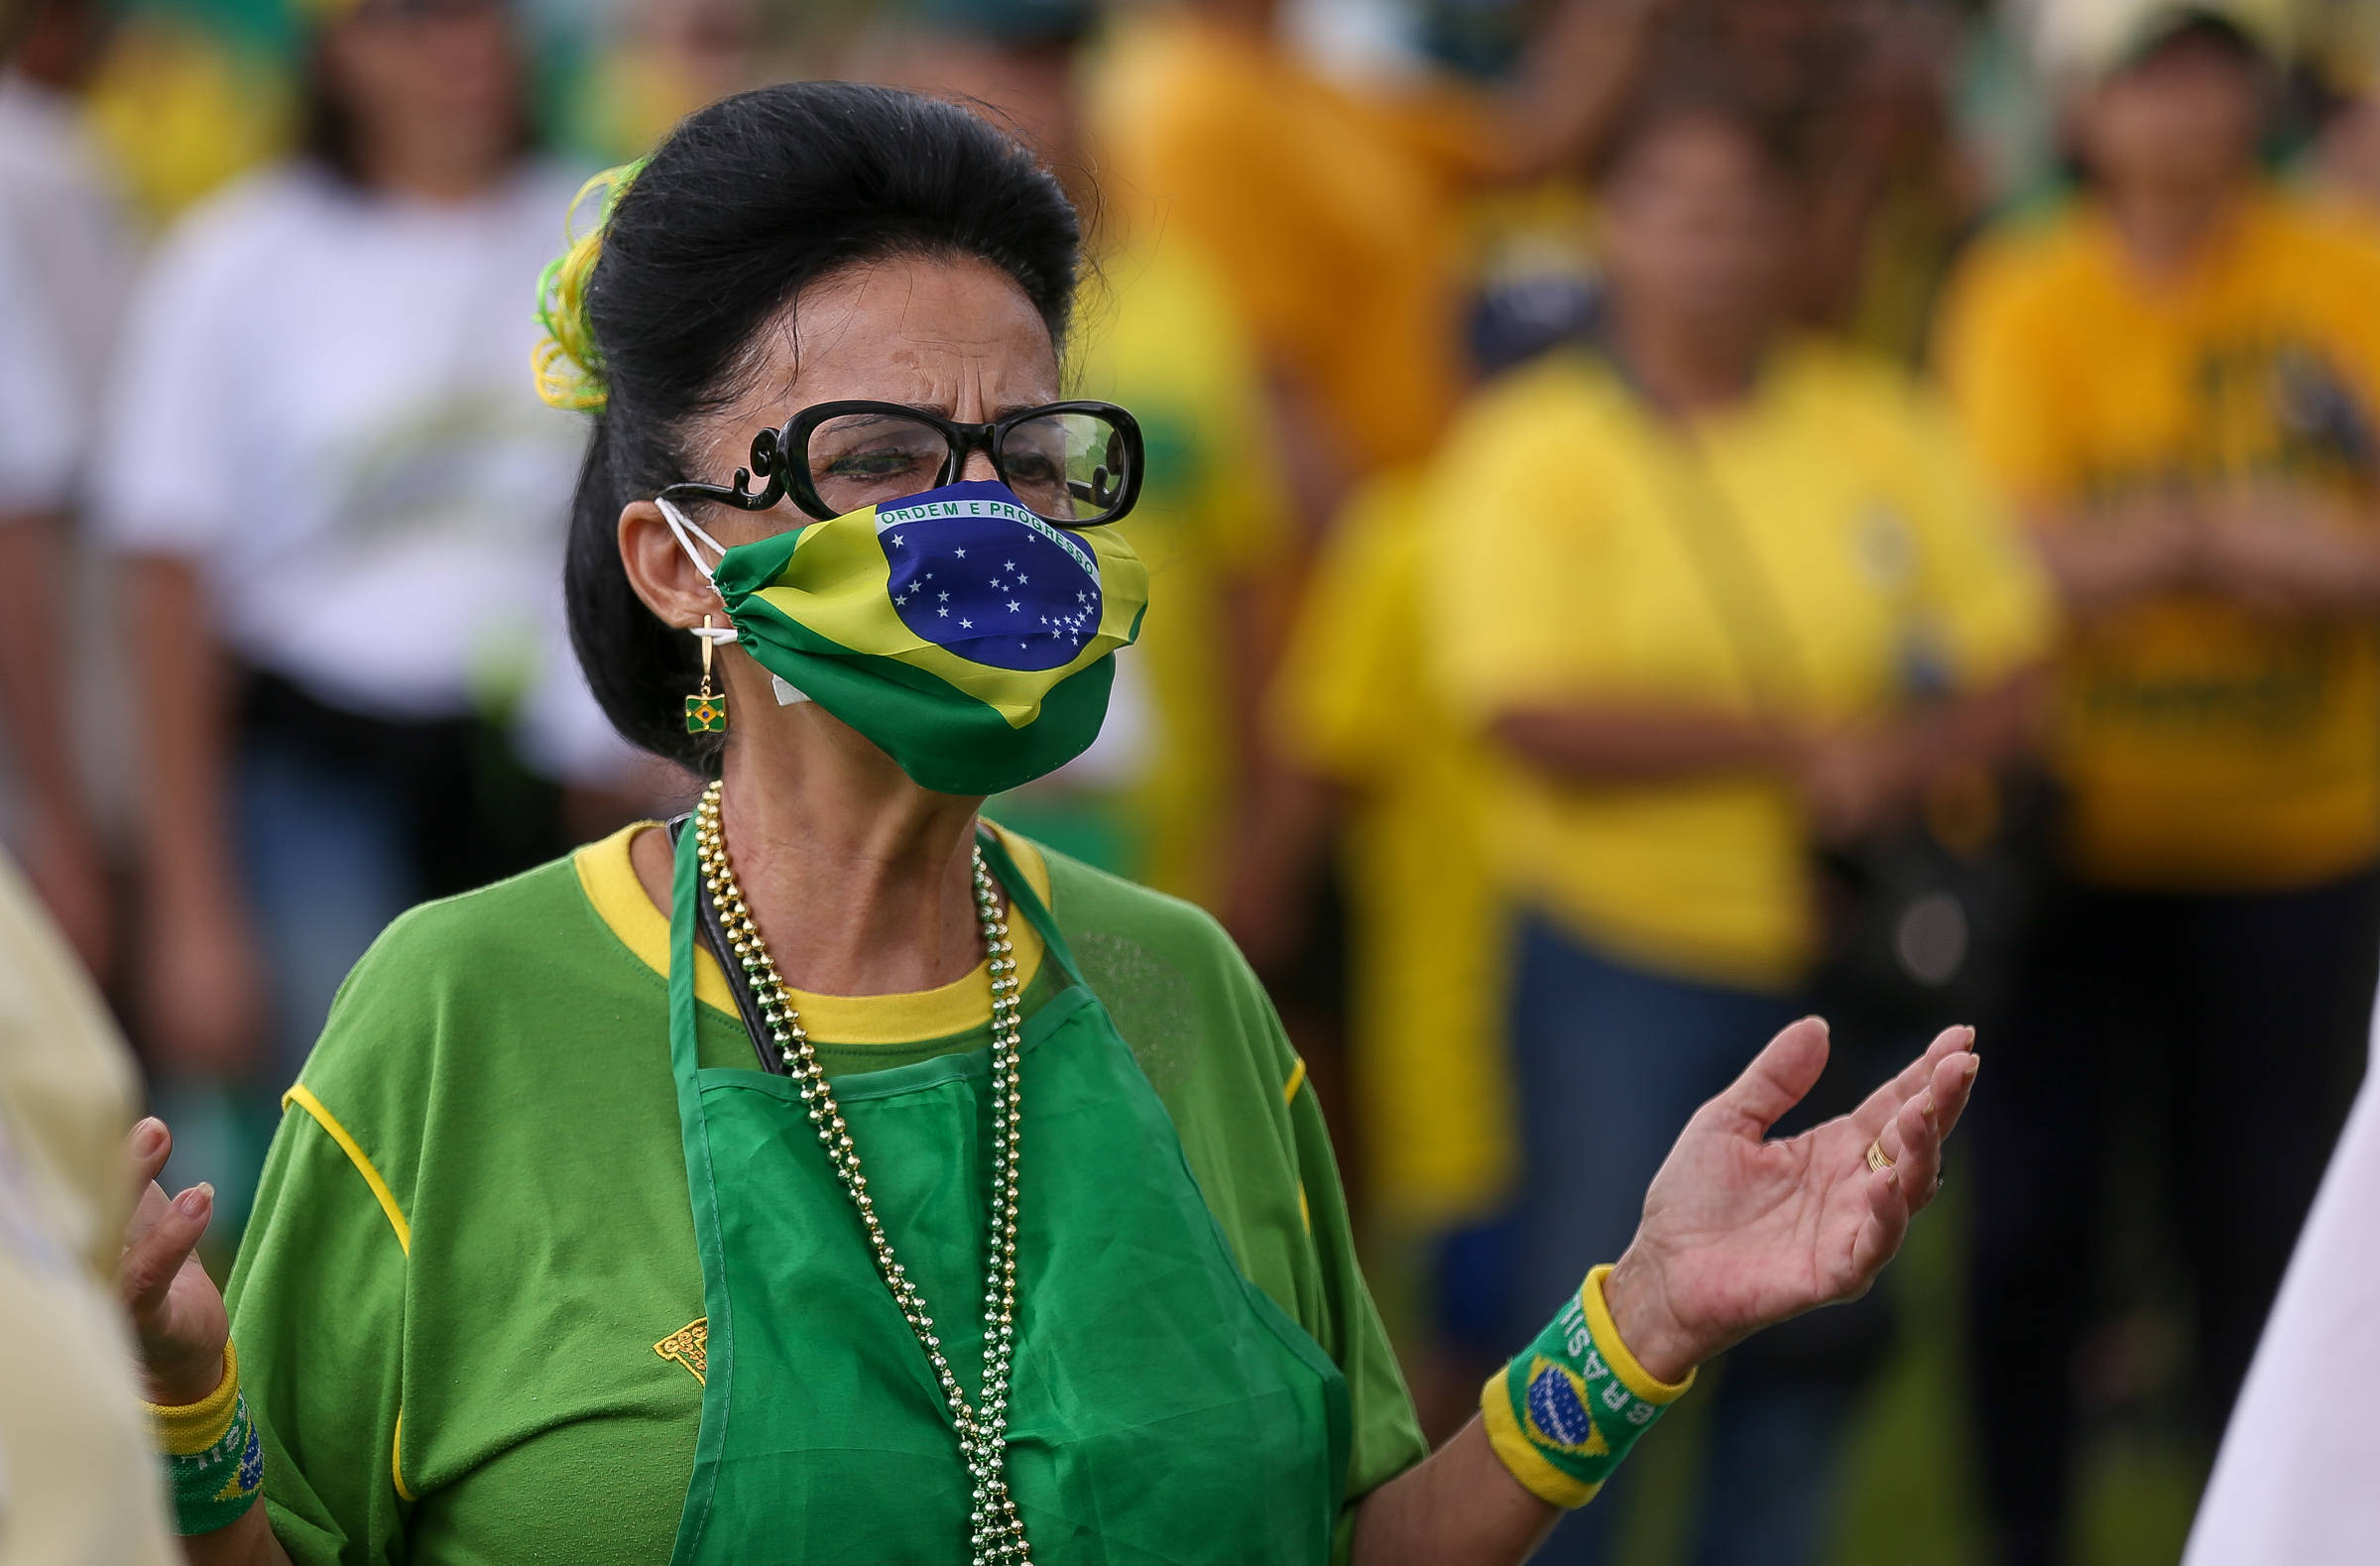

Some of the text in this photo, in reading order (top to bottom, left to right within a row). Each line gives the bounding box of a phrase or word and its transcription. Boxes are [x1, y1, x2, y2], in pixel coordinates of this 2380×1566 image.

[882, 502, 1093, 575] ORDEM E PROGRESSO
[1560, 1293, 1655, 1424] BRASIL
